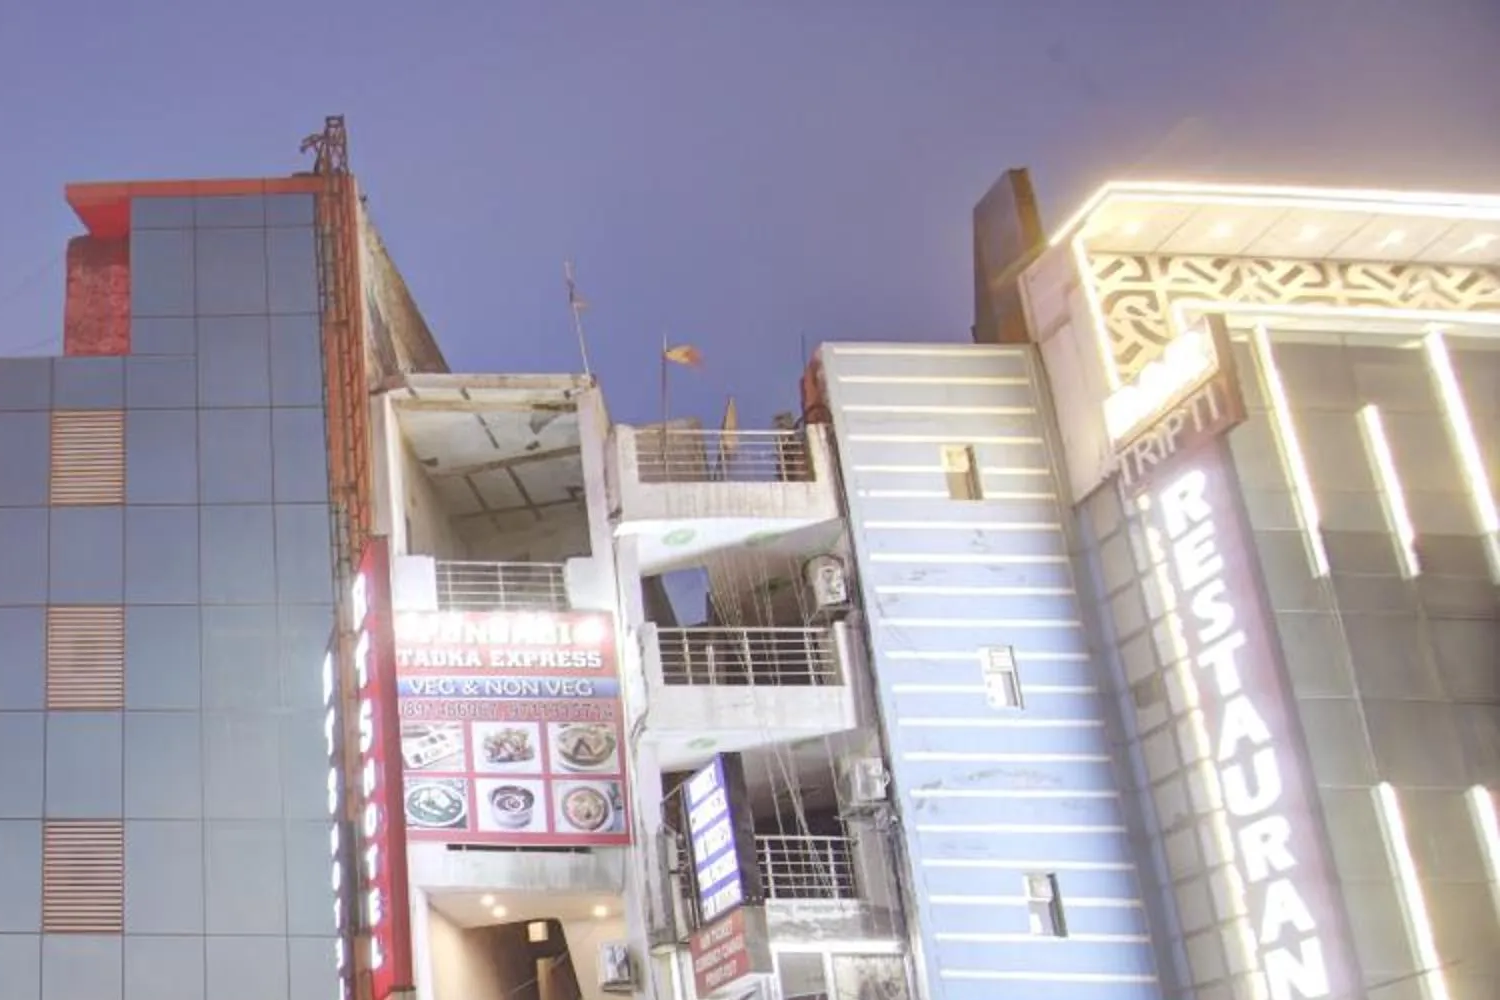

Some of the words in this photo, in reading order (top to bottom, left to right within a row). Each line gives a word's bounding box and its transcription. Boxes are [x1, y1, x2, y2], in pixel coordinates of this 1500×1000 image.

[1115, 382, 1220, 487] TRIPTI
[491, 651, 604, 668] EXPRESS
[408, 678, 456, 695] VEG
[463, 678, 479, 695] &
[485, 679, 540, 695] NON
[546, 679, 593, 695] VEG
